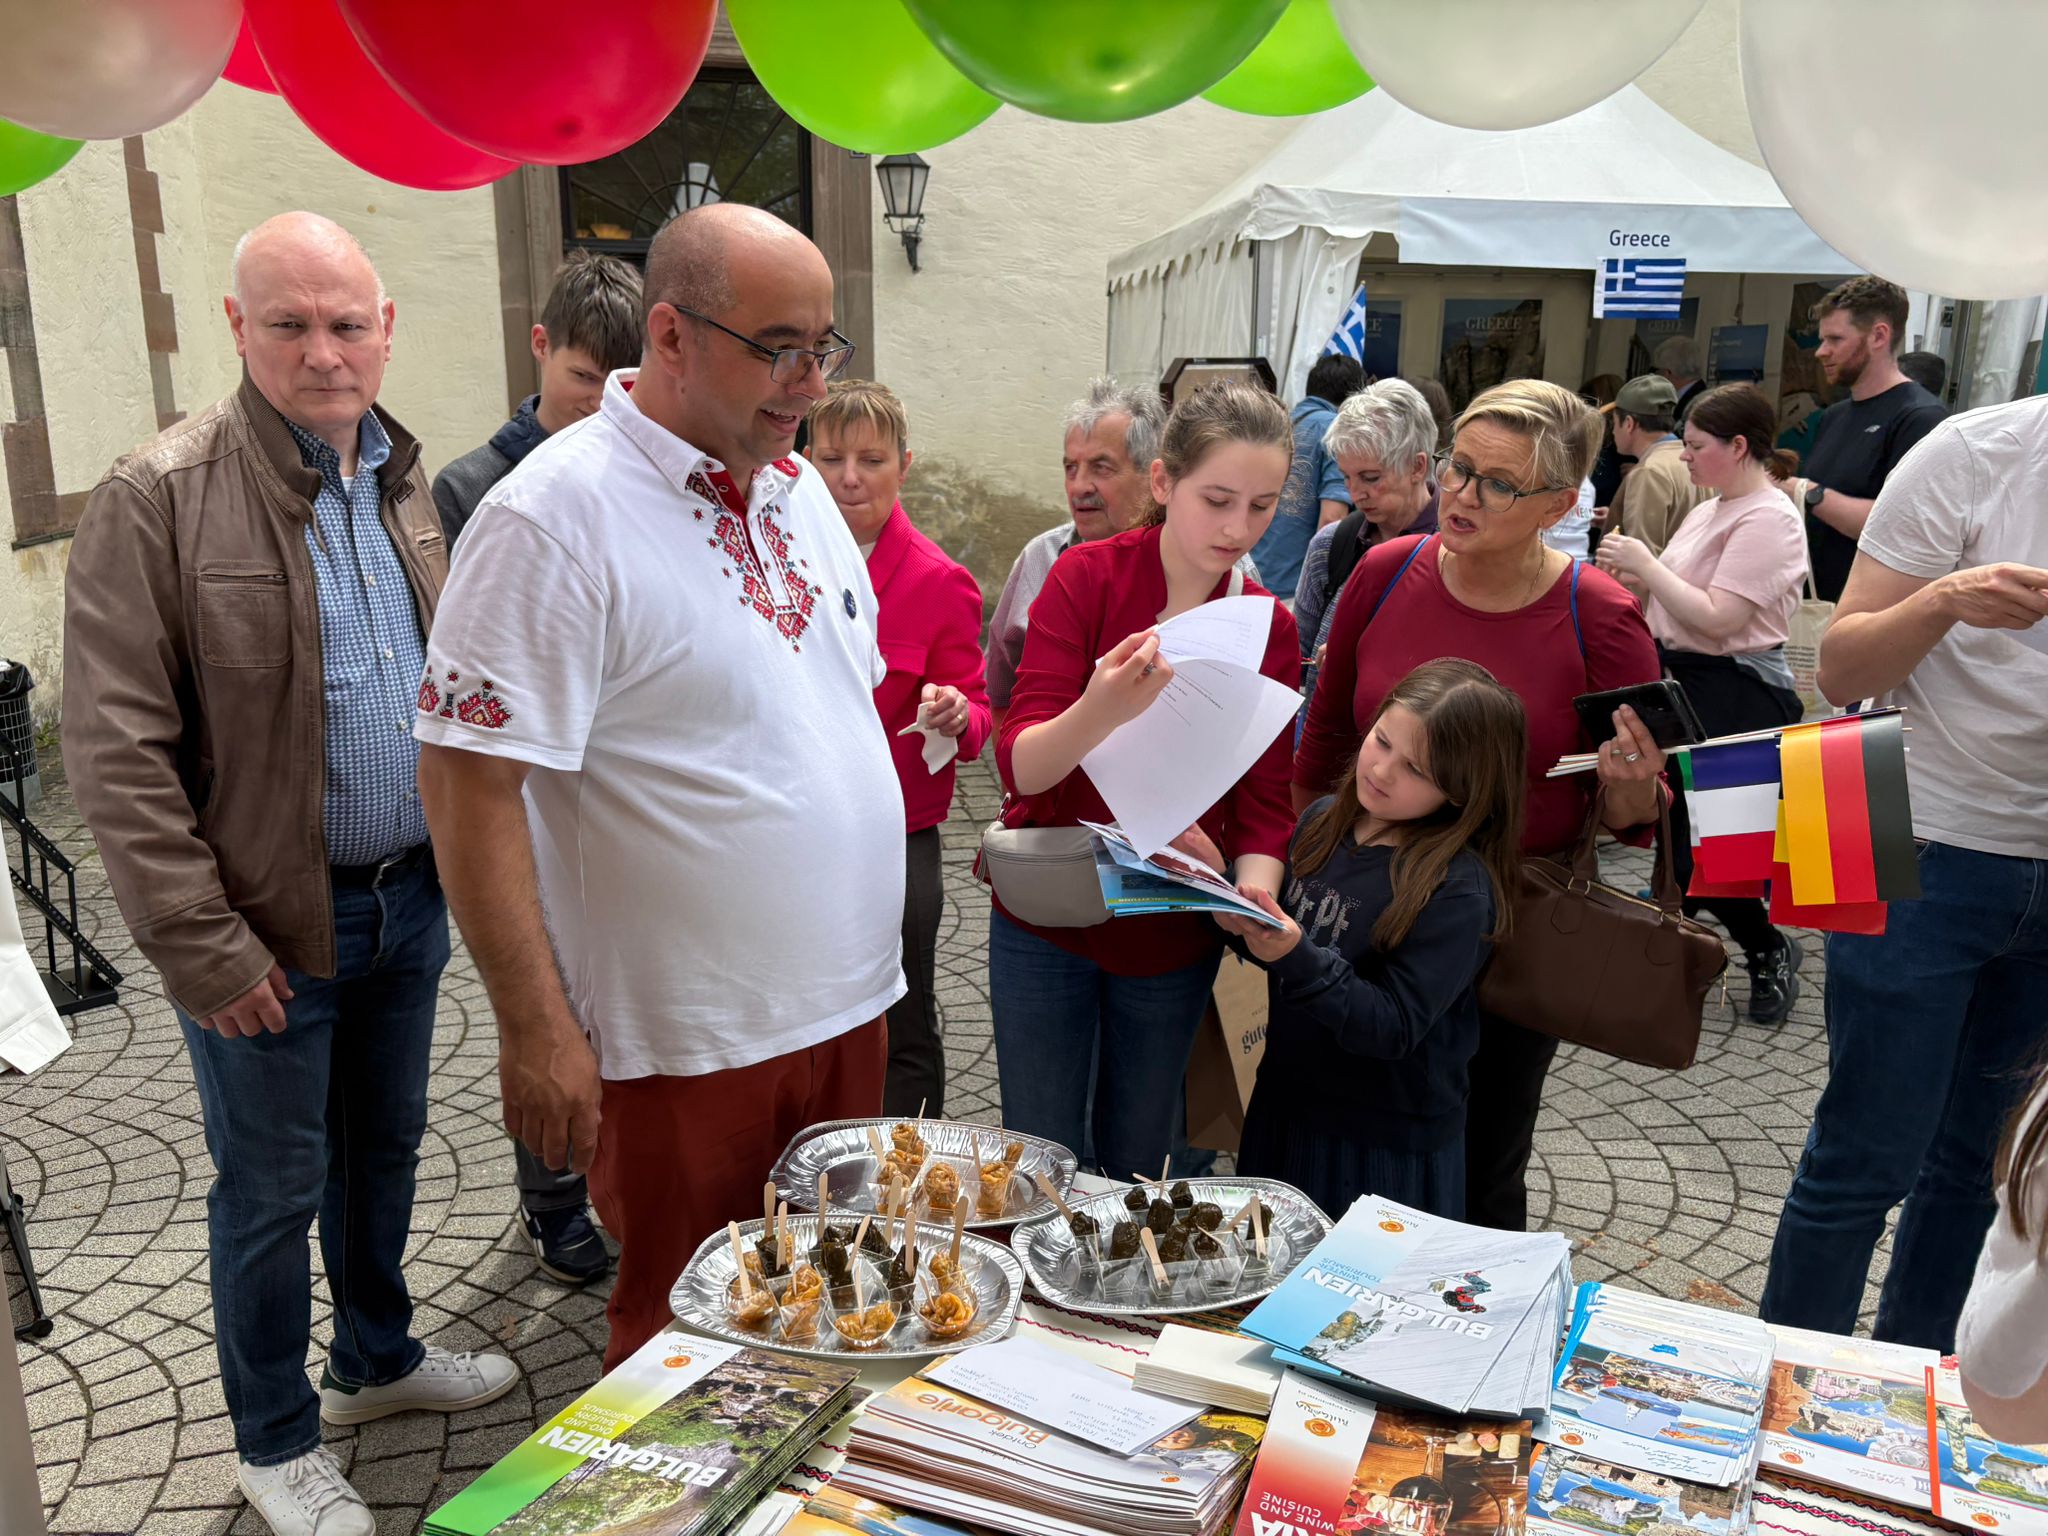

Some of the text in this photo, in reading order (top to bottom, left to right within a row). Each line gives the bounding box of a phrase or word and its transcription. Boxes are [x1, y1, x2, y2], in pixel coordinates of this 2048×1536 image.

[1608, 228, 1671, 250] Greece
[1465, 316, 1522, 330] GREECE
[1317, 1262, 1361, 1282] WINTER-
[1322, 1256, 1382, 1284] TOURISMUS
[1300, 1265, 1495, 1341] BULGARIEN
[582, 1403, 637, 1423] TOURISMUS
[916, 1393, 1052, 1445] Bulgarije
[988, 1430, 1037, 1449] Ontdek
[536, 1425, 728, 1487] BULGARIEN
[1259, 1500, 1335, 1532] WINE AND
[1261, 1491, 1322, 1518] CUISINE
